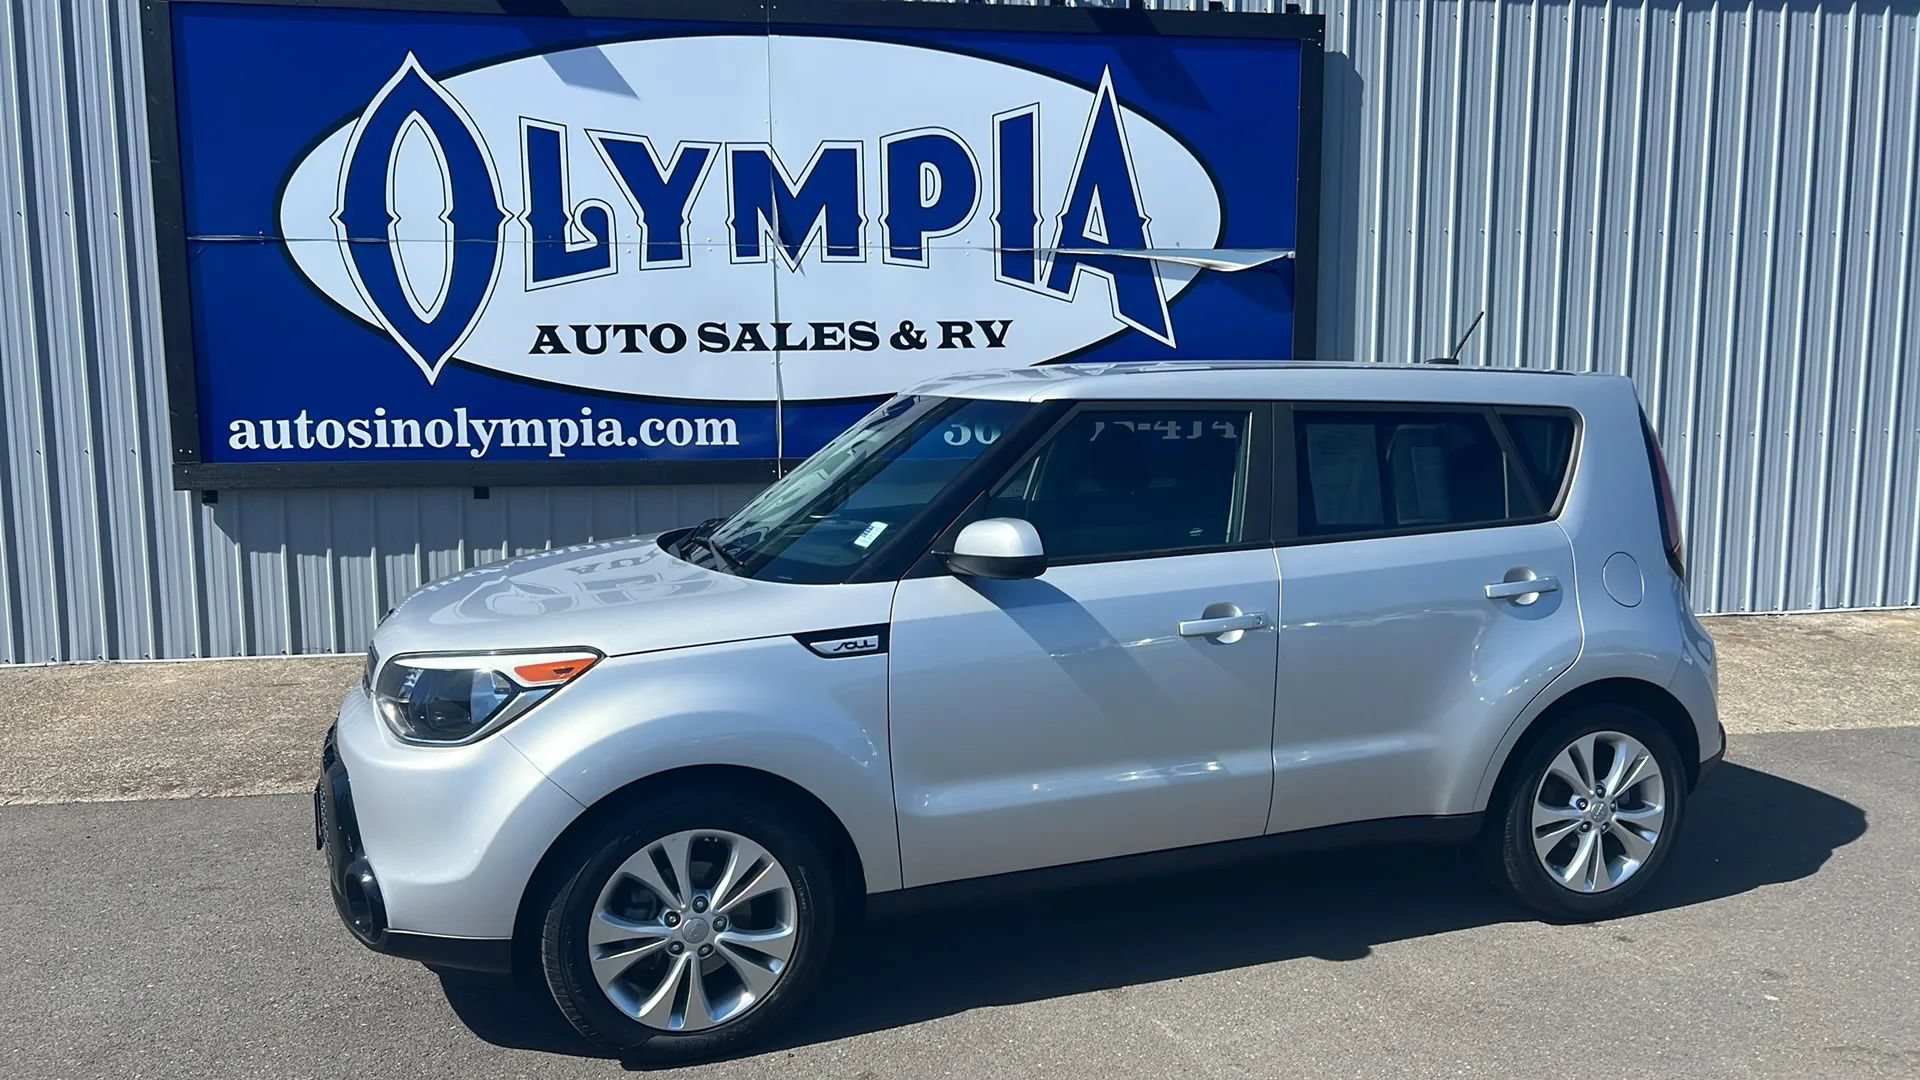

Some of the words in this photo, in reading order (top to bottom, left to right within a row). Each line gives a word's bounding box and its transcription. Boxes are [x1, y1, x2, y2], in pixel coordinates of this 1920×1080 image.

[330, 50, 1175, 386] OLYMPIA
[528, 323, 687, 354] AUTO
[698, 321, 880, 353] SALES
[889, 319, 928, 350] &
[936, 319, 1014, 349] RV
[228, 406, 739, 458] autosinolympia.com
[833, 639, 877, 652] SOUL
